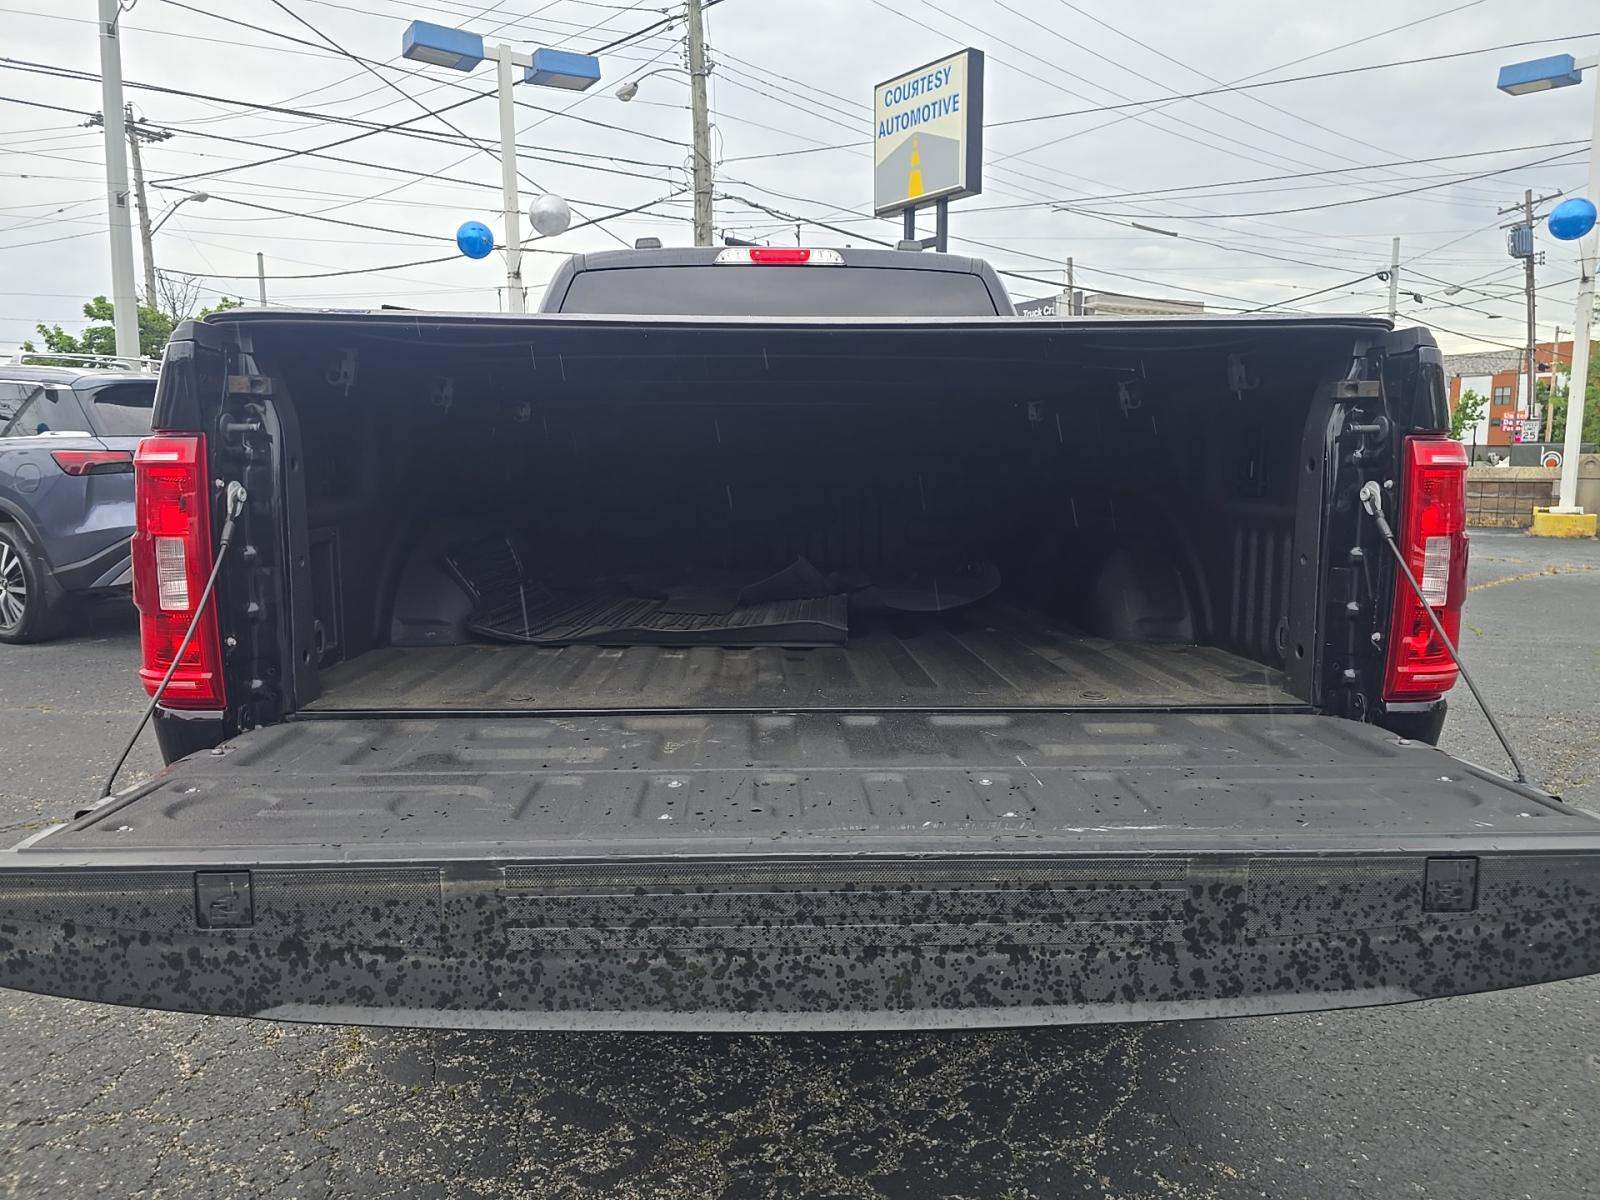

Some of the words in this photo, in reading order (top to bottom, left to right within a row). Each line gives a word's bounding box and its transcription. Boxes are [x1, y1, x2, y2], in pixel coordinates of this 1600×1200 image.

[885, 65, 952, 108] COURTESY
[878, 93, 960, 139] AUTOMOTIVE
[1023, 307, 1042, 317] Truck
[1504, 412, 1528, 420] Unted
